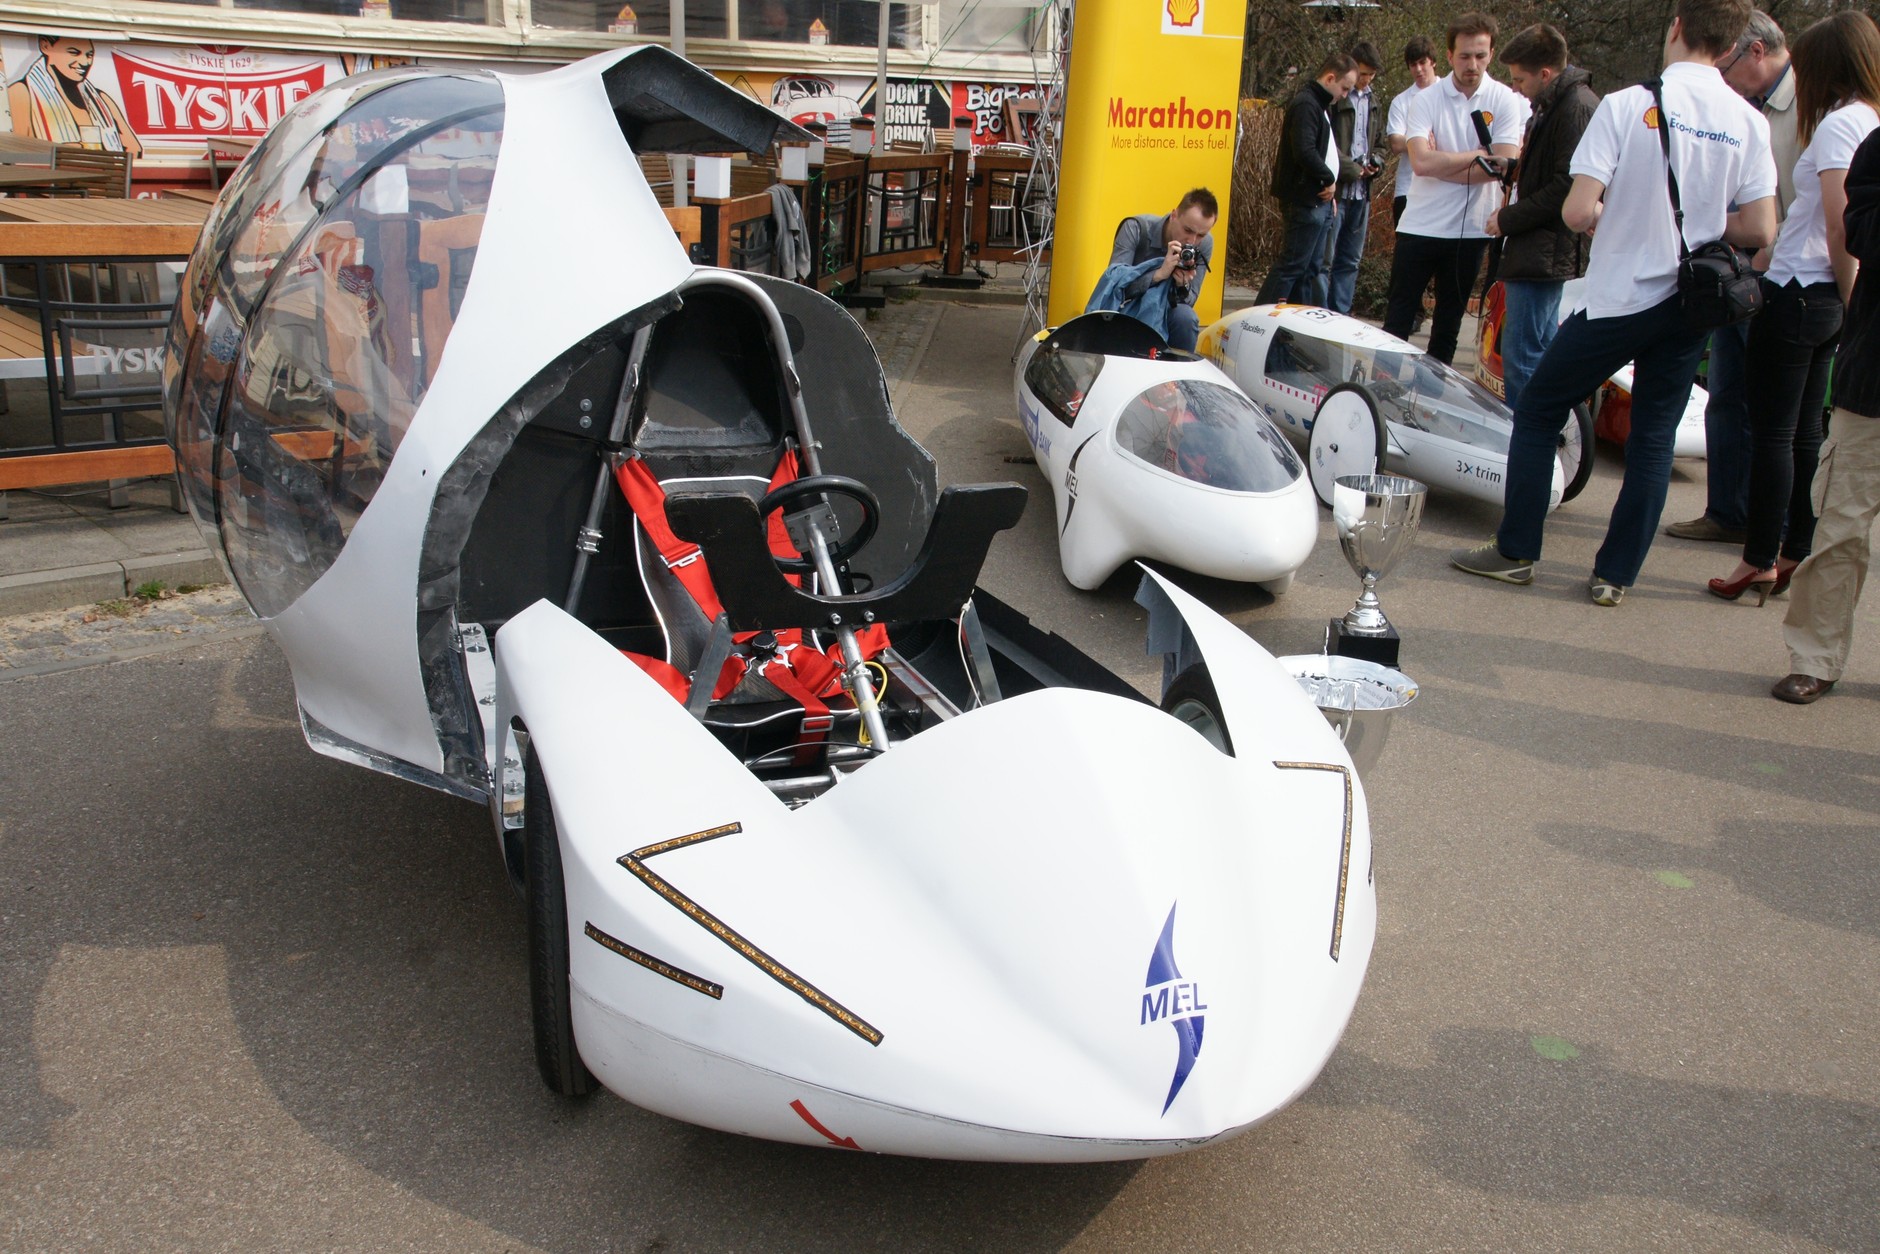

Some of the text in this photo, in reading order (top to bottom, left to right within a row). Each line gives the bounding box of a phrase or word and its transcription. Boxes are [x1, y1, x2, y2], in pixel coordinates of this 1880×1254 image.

[189, 53, 252, 69] TYSKIE 1629
[886, 84, 932, 105] DON'T
[885, 105, 931, 126] DRIVE,
[1107, 96, 1232, 130] Marathon
[1111, 133, 1230, 150] More distance. Less fuel.
[1669, 117, 1742, 149] Eco-marathon
[1244, 322, 1266, 336] BlackBerry
[1065, 471, 1079, 498] MEL
[1140, 983, 1207, 1026] MEL
